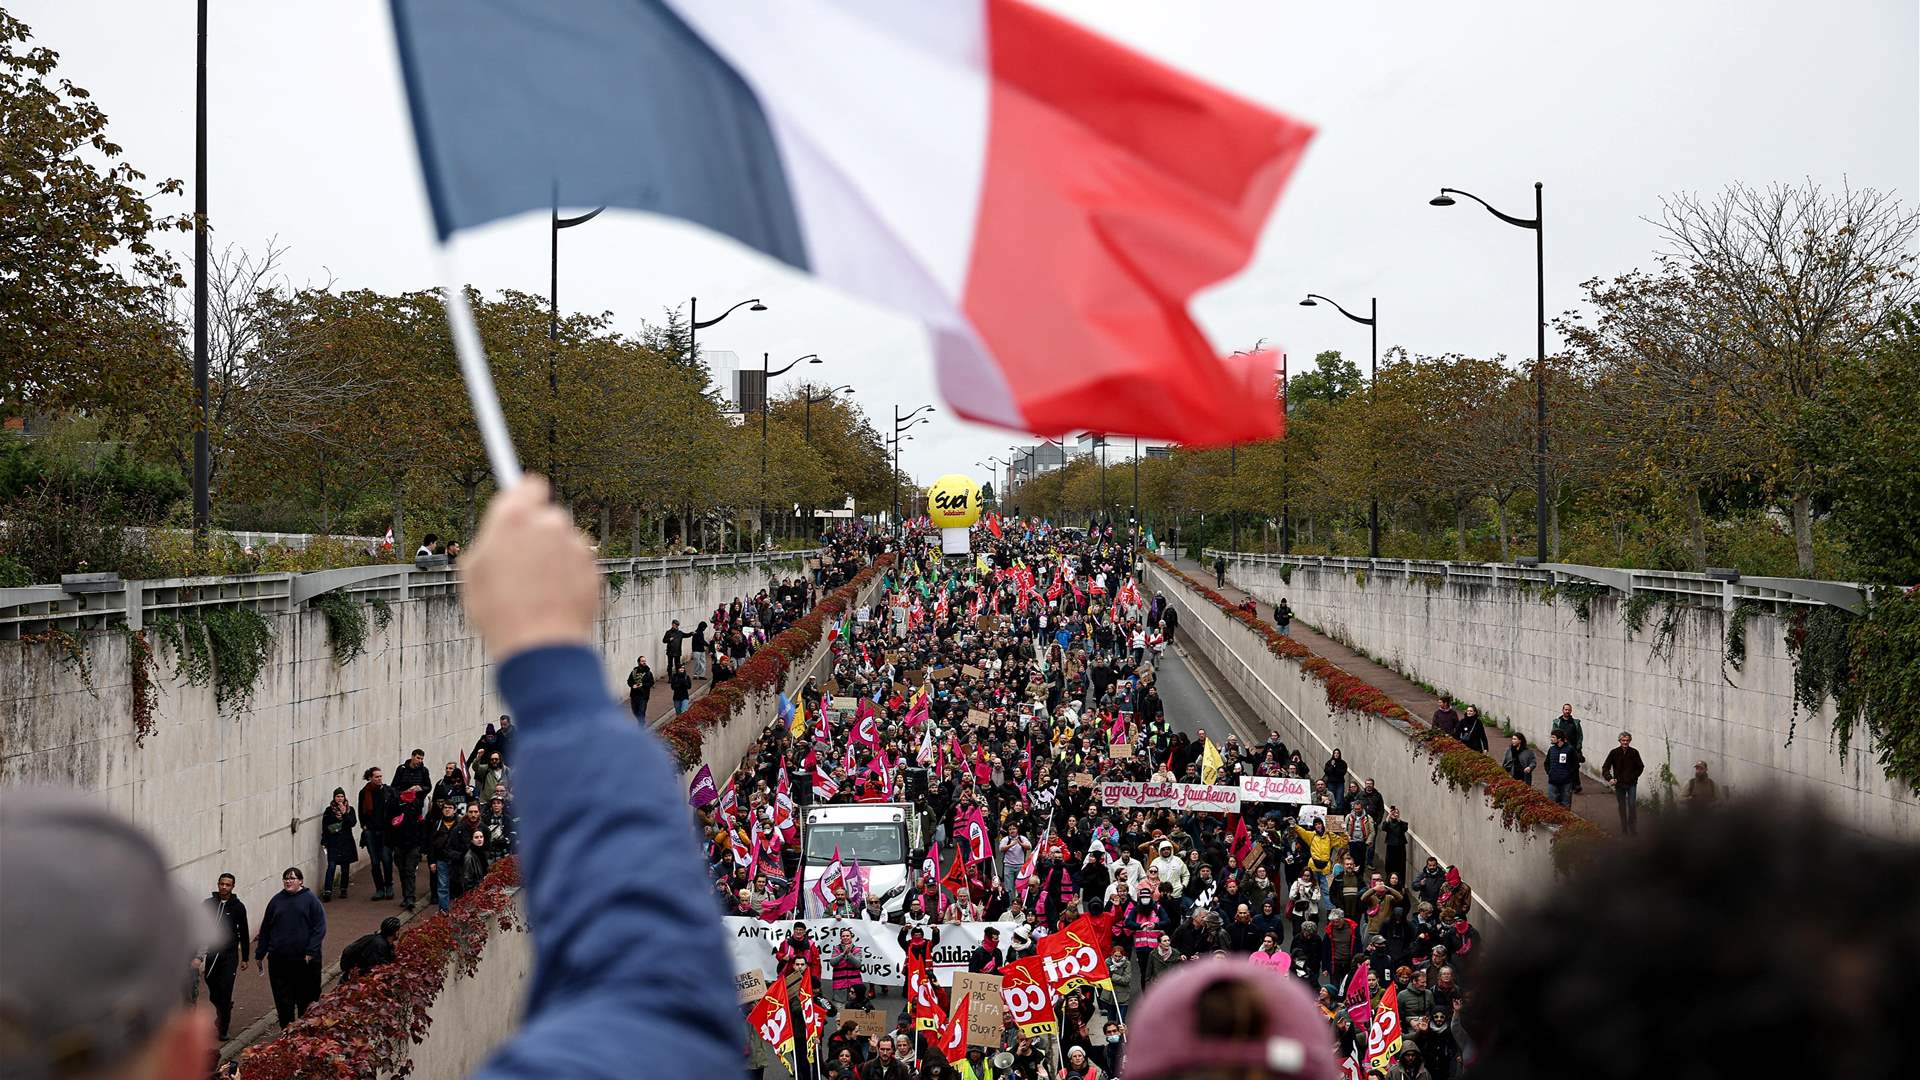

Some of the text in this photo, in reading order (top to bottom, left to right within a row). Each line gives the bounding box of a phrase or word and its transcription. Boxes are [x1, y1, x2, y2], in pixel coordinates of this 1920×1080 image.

[1178, 784, 1236, 807] faucheurs
[1244, 777, 1260, 792] de
[1259, 777, 1305, 798] fachas
[823, 958, 892, 977] TOURS
[962, 978, 999, 993] SI T'ES
[972, 991, 987, 1001] PAS
